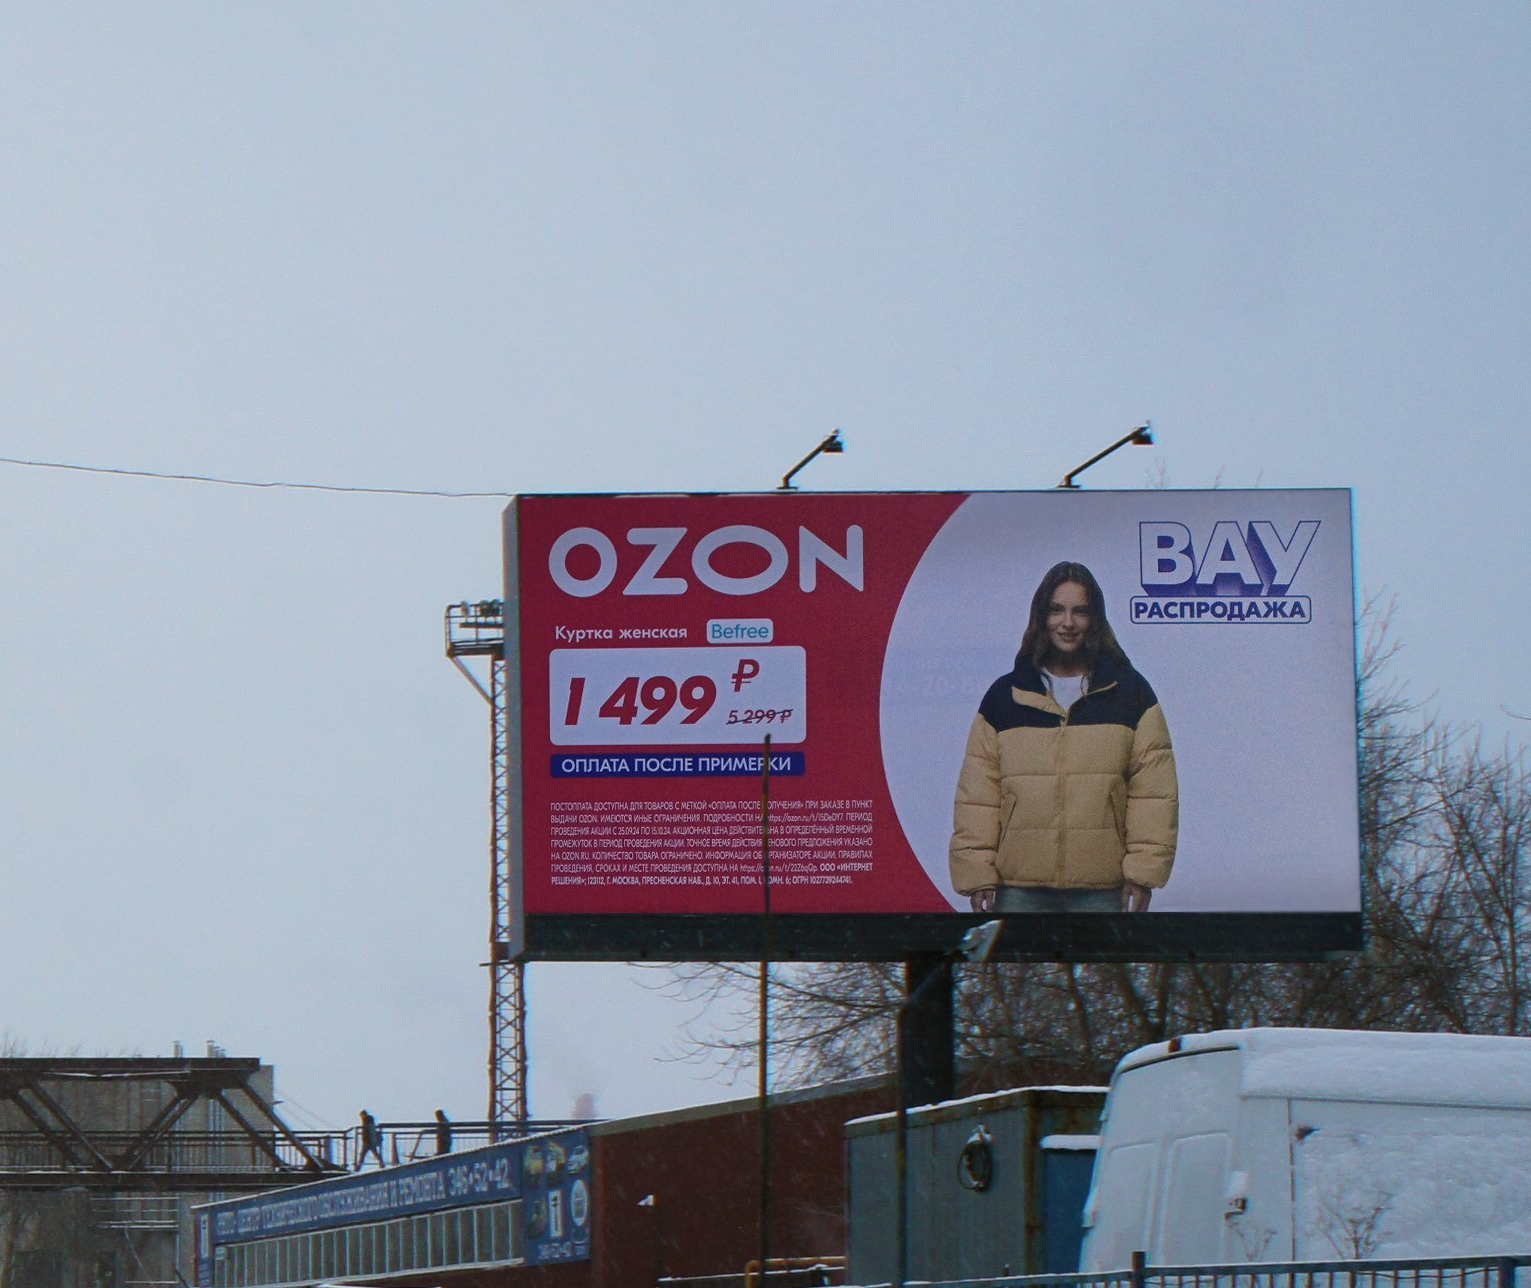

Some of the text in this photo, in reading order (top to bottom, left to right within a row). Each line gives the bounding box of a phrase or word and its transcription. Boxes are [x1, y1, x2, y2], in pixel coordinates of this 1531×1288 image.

[548, 524, 864, 598] OZON
[1134, 601, 1306, 621] РАСПРОДАЖА
[554, 626, 688, 642] Куртка женская
[711, 623, 769, 639] Befree
[561, 758, 630, 773] ОПЛАТА
[634, 757, 693, 772] ПОСЛЕ
[551, 802, 592, 811] ПОСТОПЛАТА
[594, 802, 628, 812] ДОСТУПНА
[630, 801, 643, 812] ДЛЯ
[644, 801, 674, 811] ТОВАРОВ
[675, 801, 680, 810] С
[681, 800, 707, 810] МЕТКОЙ
[708, 801, 737, 810] «ОПЛАТА
[738, 801, 761, 810] ПОСЛЕ
[805, 800, 819, 810] ПРИ
[820, 800, 844, 809] ЗАКАЗЕ
[851, 800, 873, 809] ПУНКТ
[551, 814, 577, 824] ВЫДАЧИ
[600, 814, 632, 823] ИМЕЮТСЯ
[634, 814, 652, 823] ИНЫЕ
[704, 813, 753, 823] ПОДРОБНОСТИ
[846, 812, 873, 822] ПЕРИОД
[551, 827, 589, 837] ПРОВЕДЕНИЯ
[591, 826, 611, 837] АКЦИИ
[640, 826, 650, 835] ПО
[672, 826, 711, 836] АКЦИОННАЯ
[712, 826, 727, 836] ЦЕНА
[835, 824, 872, 834] ВРЕМЕННОЙ
[551, 839, 592, 848] ПРОМЕЖУТОК
[599, 839, 623, 849] ПЕРИОД
[624, 839, 662, 849] ПРОВЕДЕНИЯ
[687, 838, 710, 847] ТОЧНОЕ
[712, 838, 730, 847] ВРЕМЯ
[731, 837, 762, 848] ДЕЙСТВИЯ
[797, 838, 842, 848] ПРЕДЛОЖЕНИЯ
[844, 837, 872, 846] УКАЗАНО
[551, 852, 560, 861] НА
[592, 851, 634, 860] КОЛИЧЕСТВО
[635, 851, 659, 860] ТОВАРА
[705, 851, 751, 861] ИНФОРМАЦИЯ
[838, 850, 873, 859] ПРАВИЛАХ
[595, 864, 621, 873] СРОКАХ
[622, 864, 628, 873] И
[629, 864, 649, 873] МЕСТЕ
[650, 863, 692, 874] ПРОВЕДЕНИЯ
[693, 863, 728, 873] ДОСТУПНА
[729, 863, 738, 872] НА
[820, 862, 835, 872] ООО
[642, 876, 687, 885] ПРЕСНЕНСКАЯ
[792, 876, 809, 885] ОГРН
